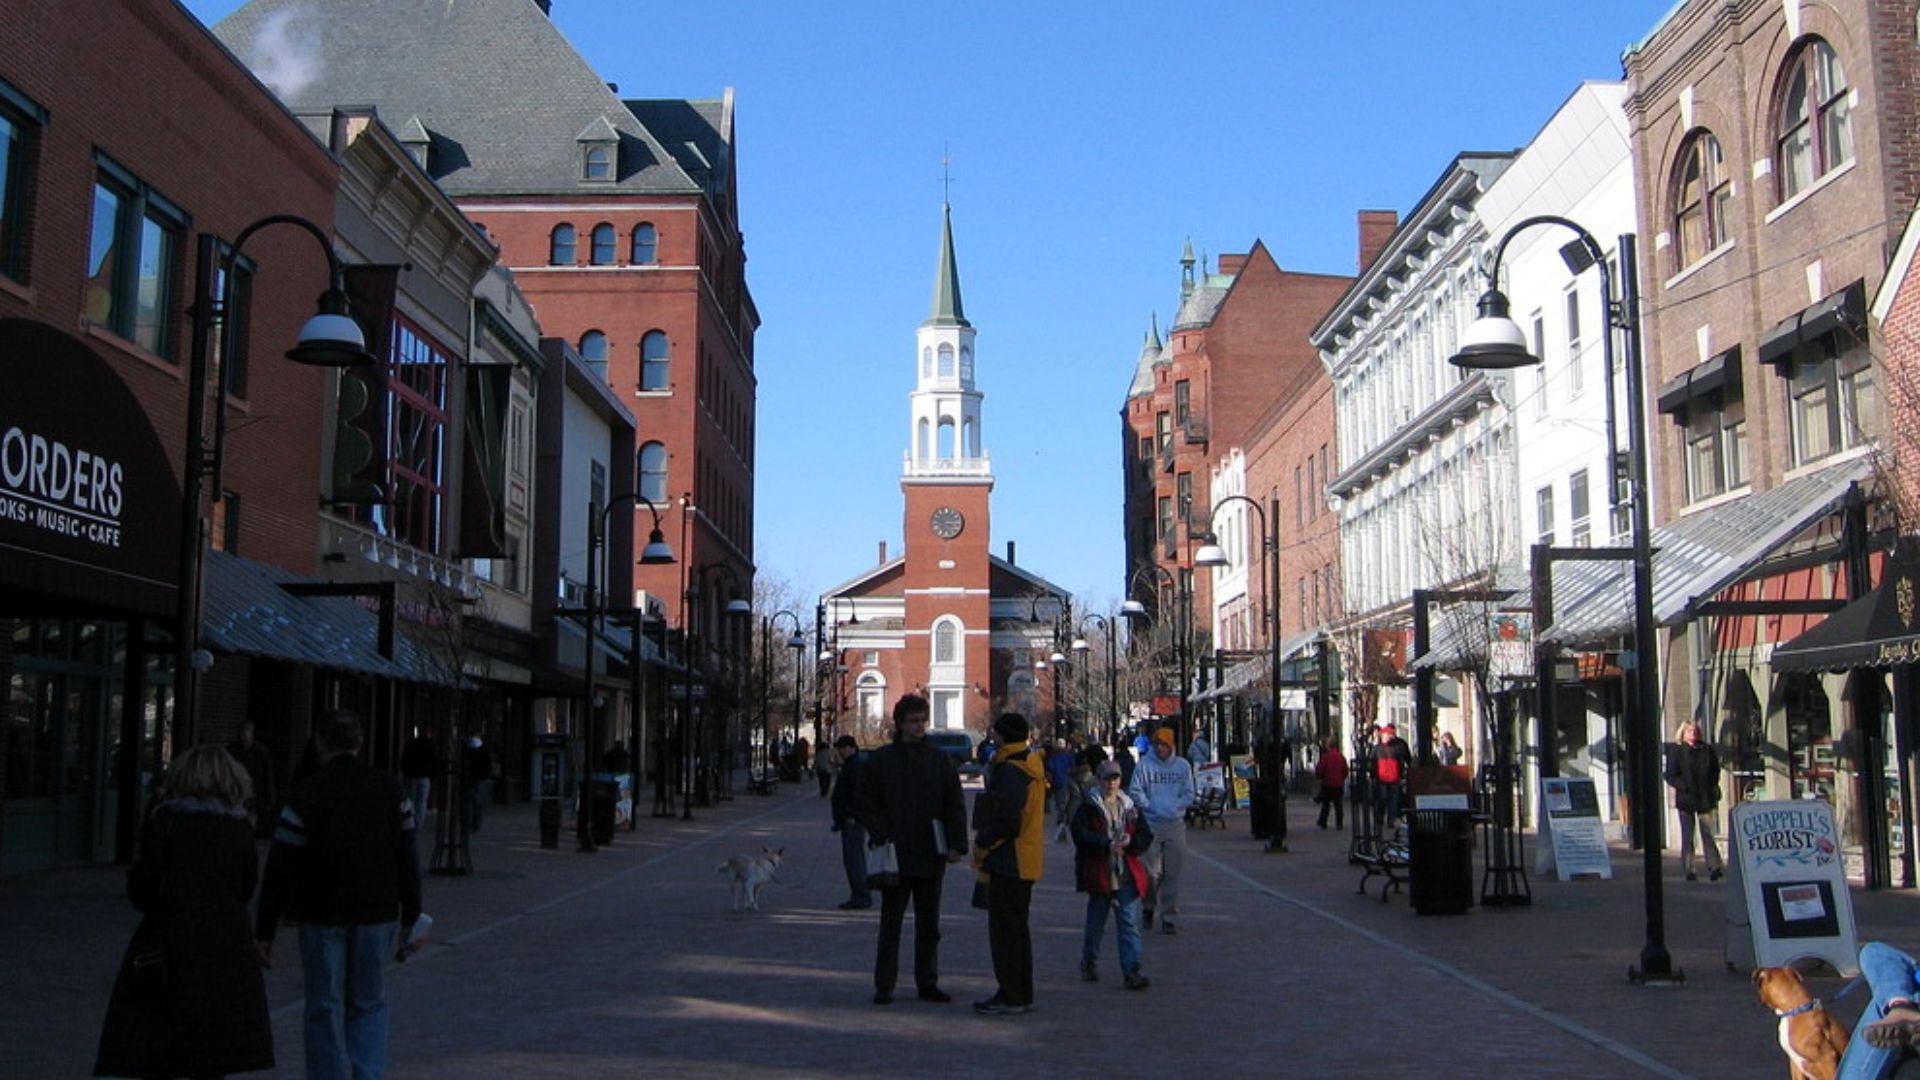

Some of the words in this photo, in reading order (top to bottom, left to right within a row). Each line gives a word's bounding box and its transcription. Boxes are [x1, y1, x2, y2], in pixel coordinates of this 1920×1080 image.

[37, 508, 80, 537] MUSIC
[88, 523, 121, 548] CAFE
[1743, 810, 1830, 835] CHAPPELL'S
[1748, 829, 1815, 852] FLORIST
